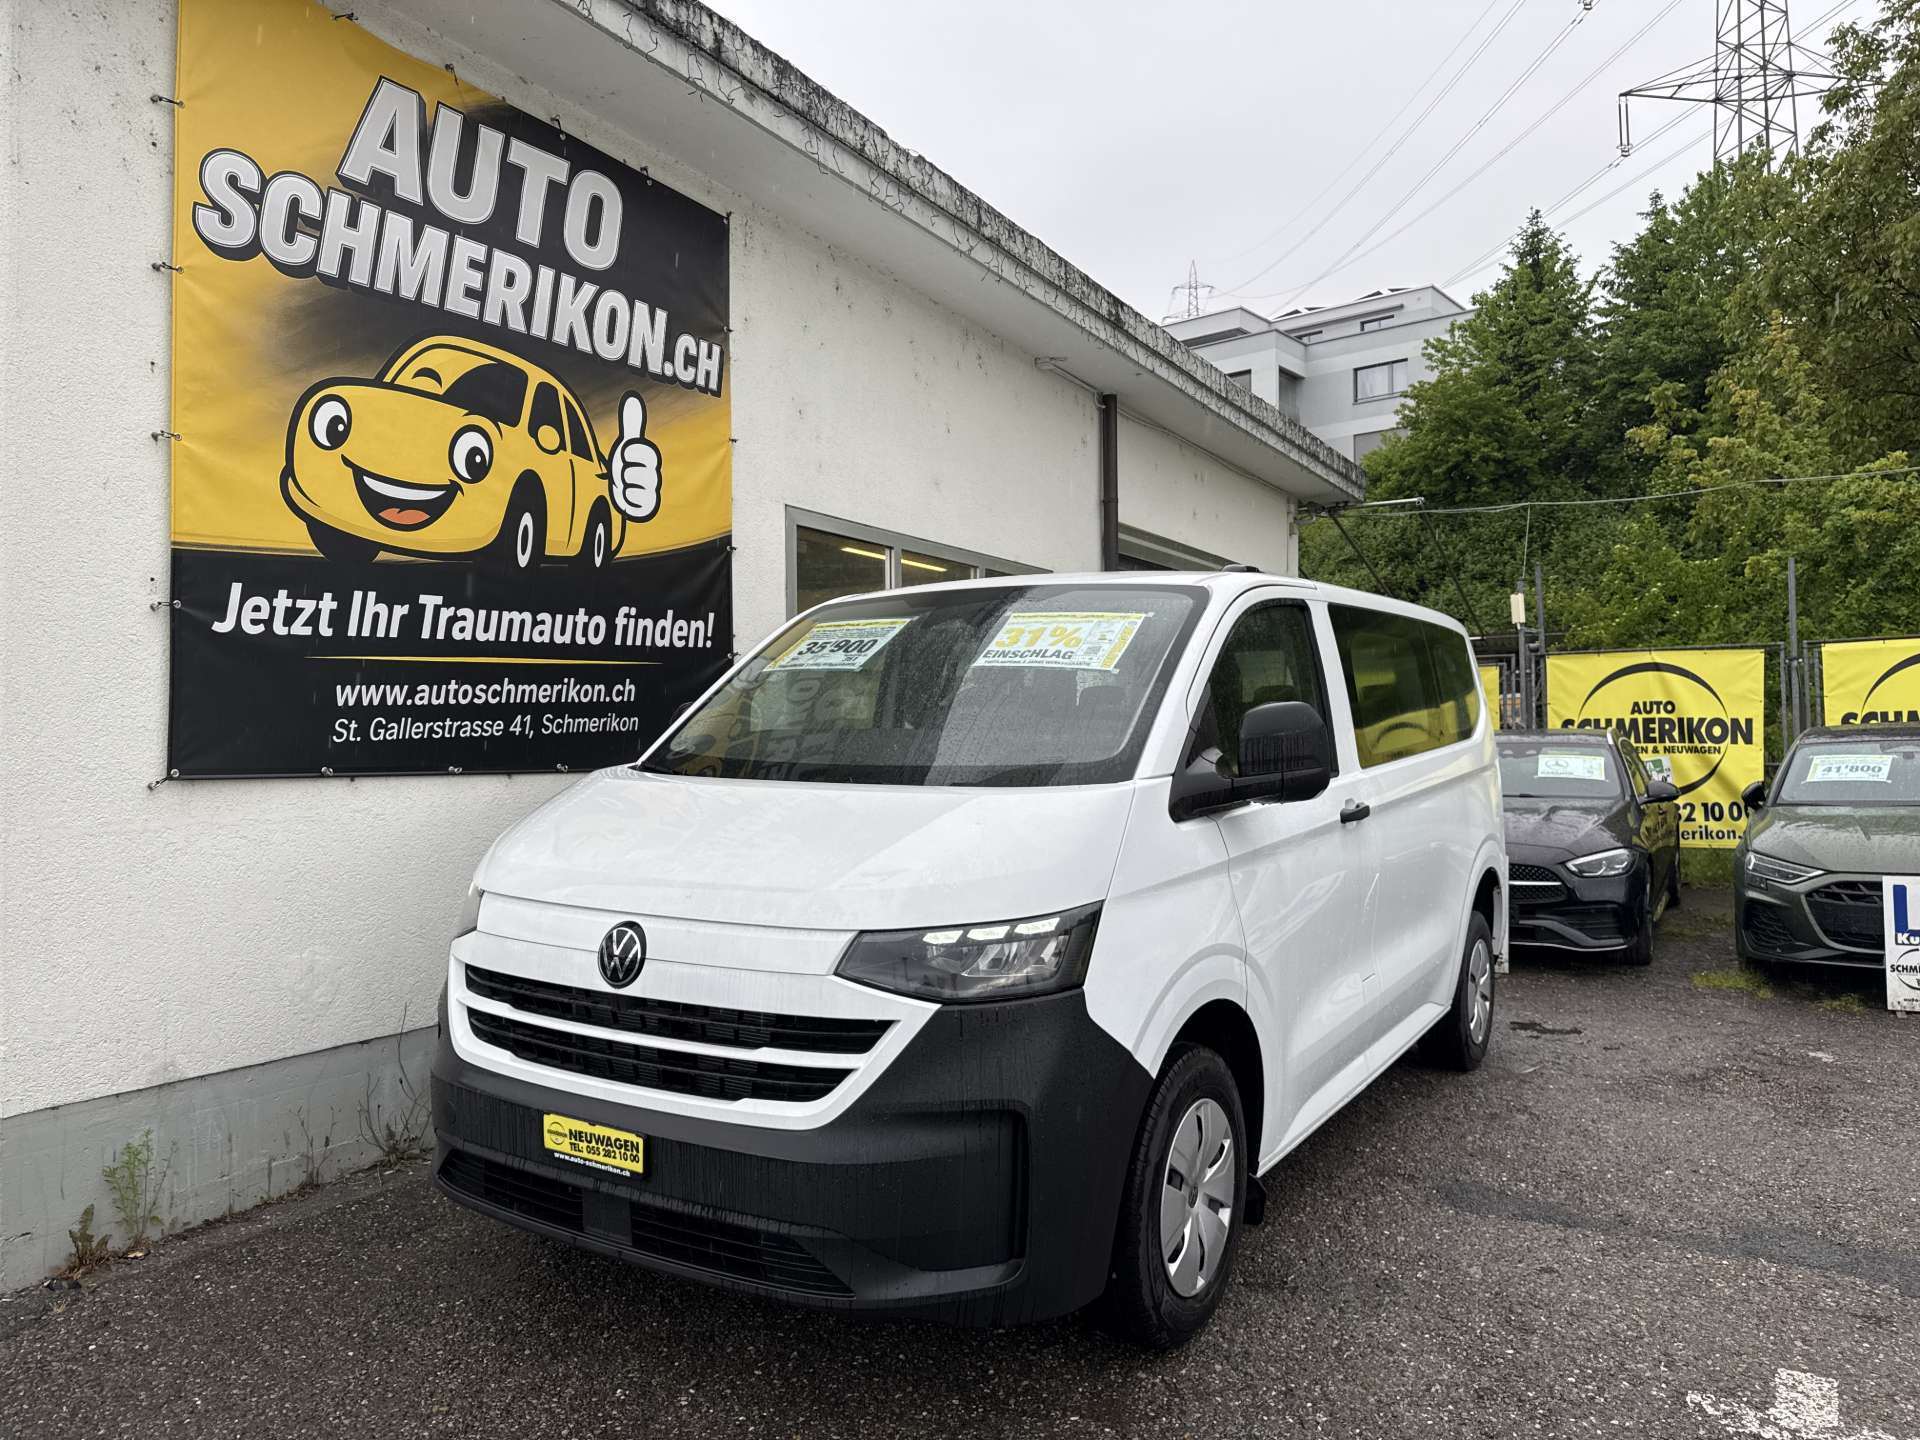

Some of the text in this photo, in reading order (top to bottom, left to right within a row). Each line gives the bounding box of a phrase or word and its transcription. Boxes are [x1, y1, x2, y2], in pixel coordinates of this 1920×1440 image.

[337, 75, 625, 271] AUTO
[194, 151, 724, 393] SCHMERIKON.CH
[211, 582, 715, 648] Jetzt Ihr Traumauto finden!
[797, 638, 878, 656] 35'900
[982, 648, 1075, 660] EINSCHLAG
[336, 678, 636, 707] www.autoschmerikon.ch
[1630, 700, 1677, 715] AUTO
[332, 713, 639, 743] St. Gallerstrasse 41, Schmerikon
[1652, 745, 1660, 755] &
[1663, 745, 1721, 755] NEUWAGEN
[1701, 802, 1724, 822] 10
[1728, 801, 1748, 822] 0
[1890, 964, 1920, 973] SCHM
[568, 1129, 640, 1153] NEUWAGEN
[569, 1142, 640, 1164] TEL: 055 282 10 00
